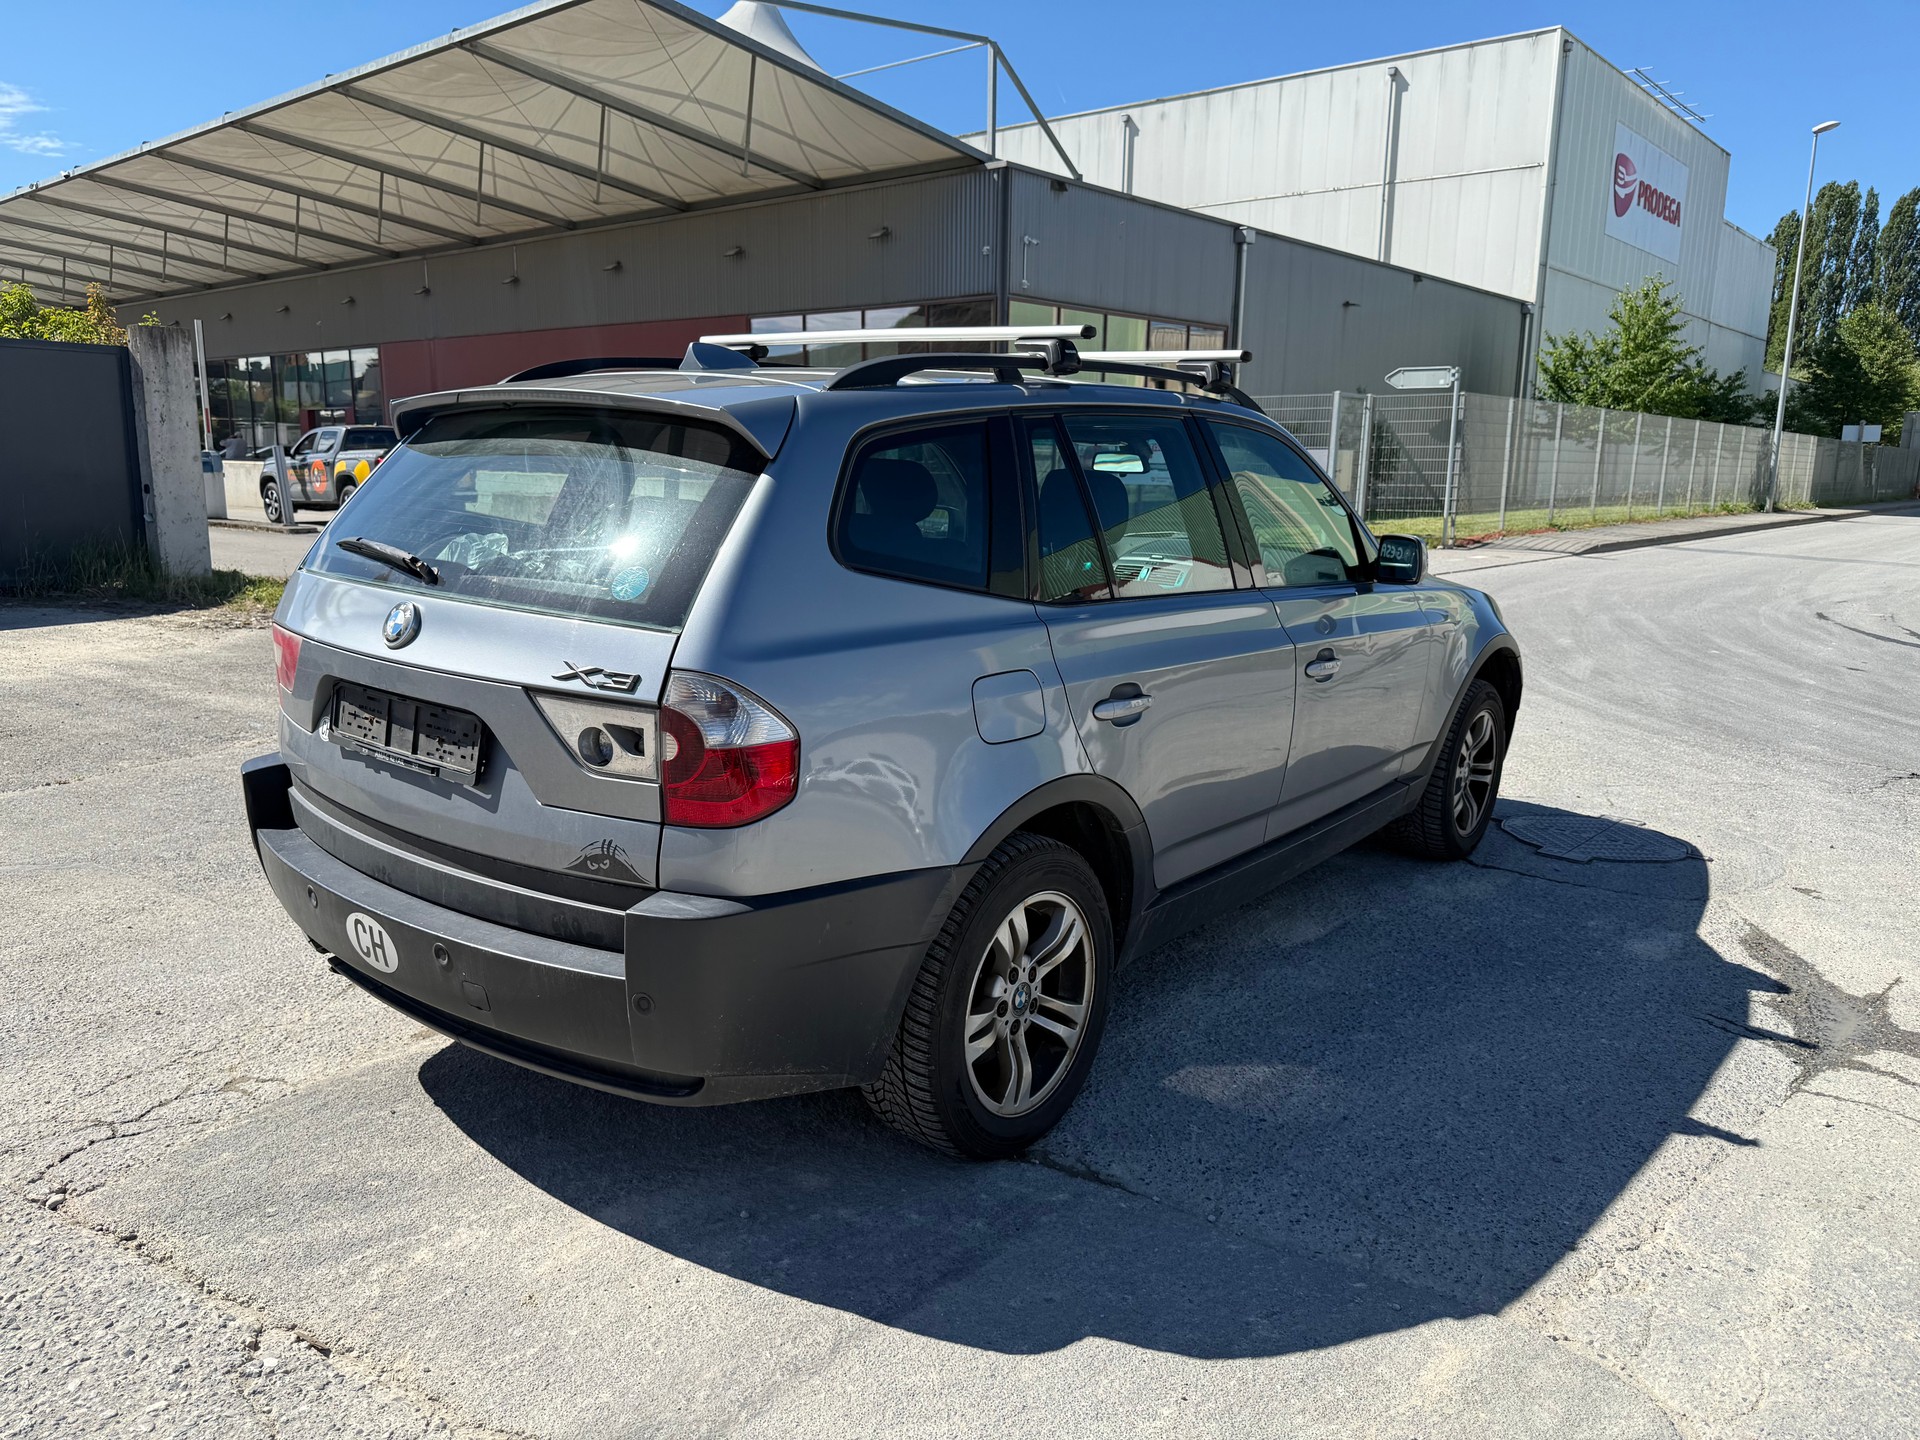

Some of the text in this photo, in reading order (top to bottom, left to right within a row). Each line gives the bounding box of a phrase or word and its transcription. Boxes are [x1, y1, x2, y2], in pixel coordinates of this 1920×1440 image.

[1637, 180, 1681, 227] PRODEGA
[551, 660, 642, 694] X3
[354, 918, 390, 968] CH
